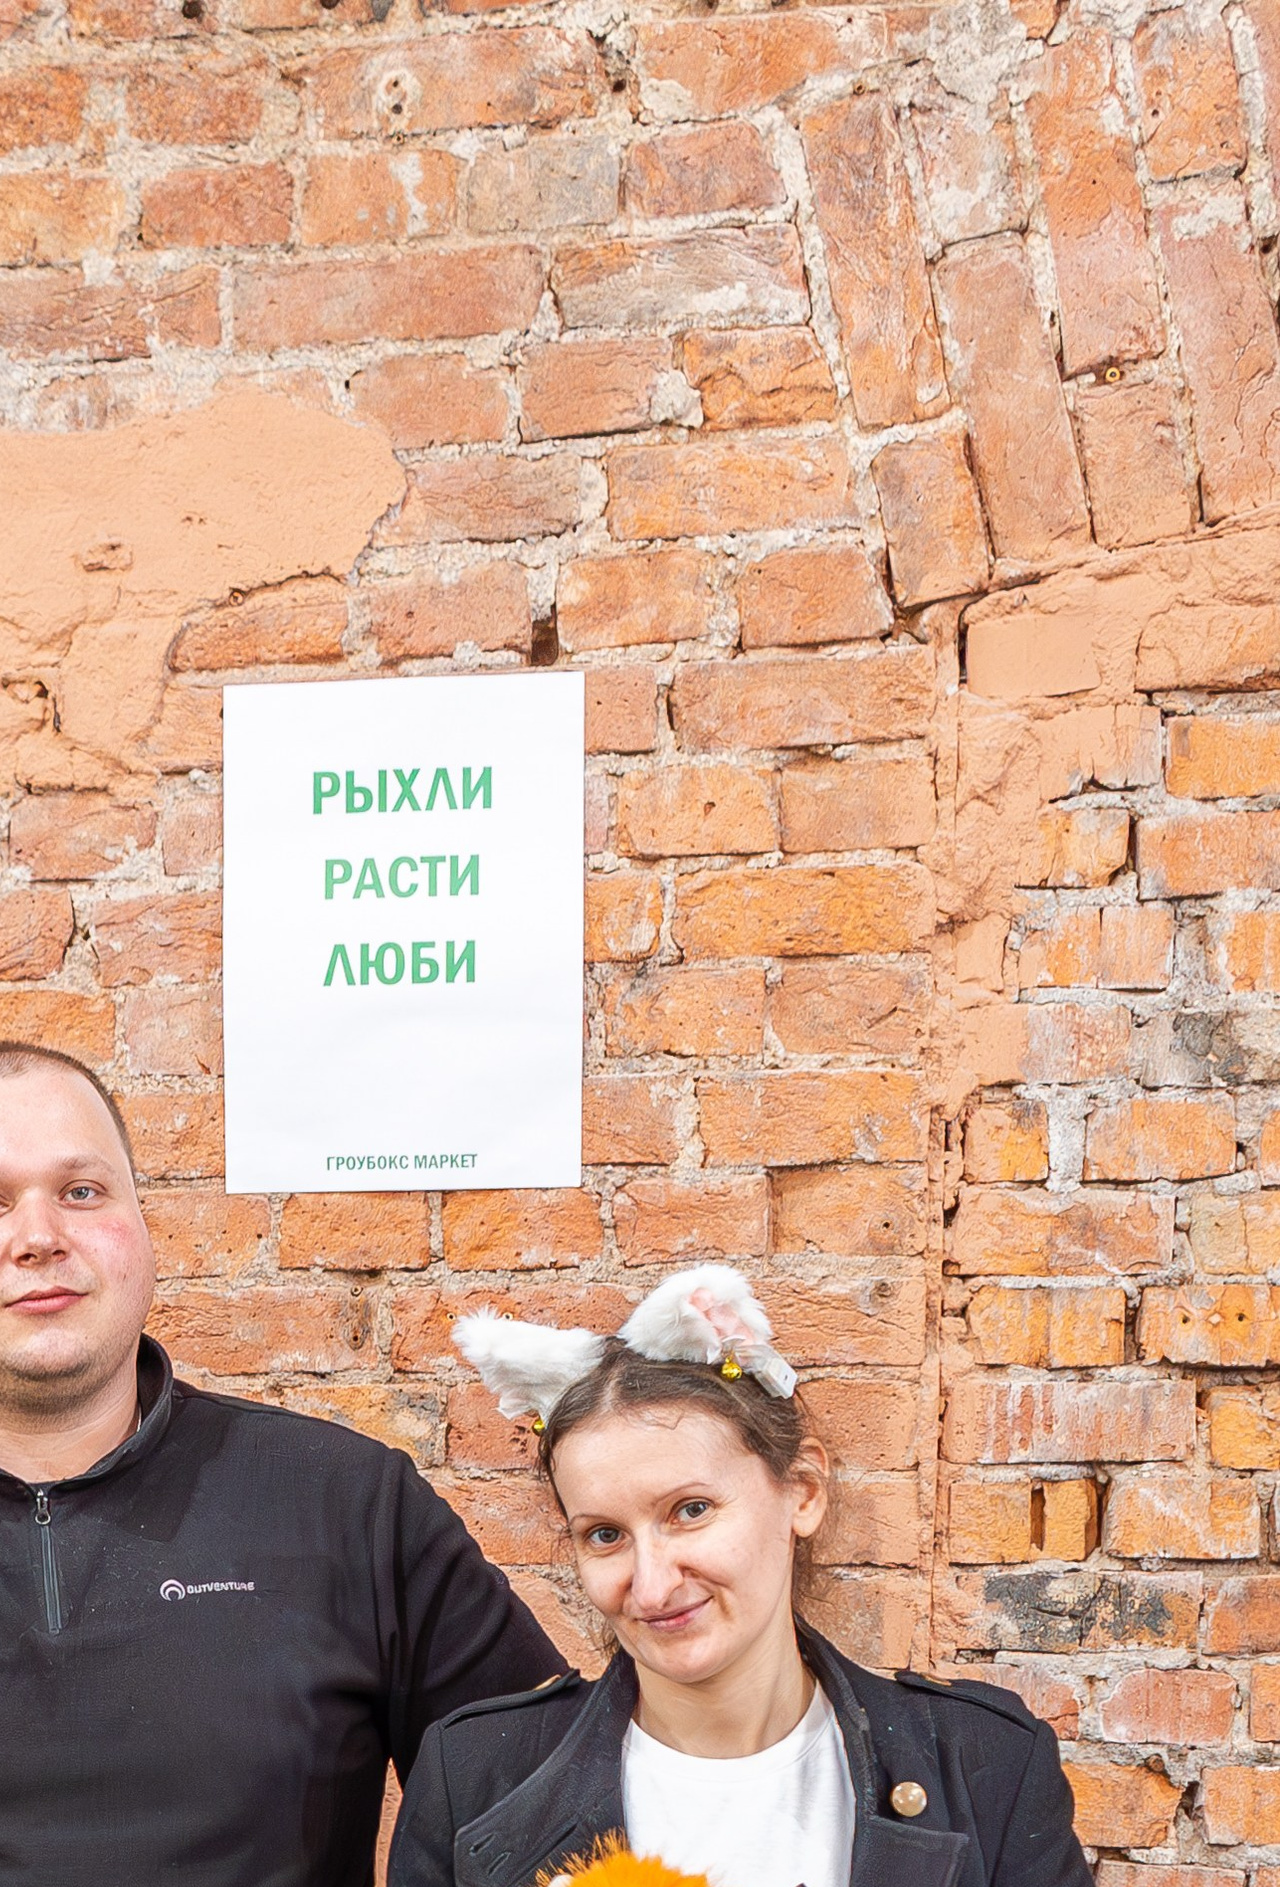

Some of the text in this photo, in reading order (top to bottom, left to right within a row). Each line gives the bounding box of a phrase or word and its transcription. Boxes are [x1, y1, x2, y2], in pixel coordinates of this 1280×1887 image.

[313, 766, 492, 815] РЫХЛИ
[324, 854, 480, 900] РАСТИ
[323, 940, 476, 987] ЛЮБИ
[326, 1153, 478, 1171] ГРОУБОКС МАРКЕТ
[187, 1581, 255, 1594] OUTVENTURE
